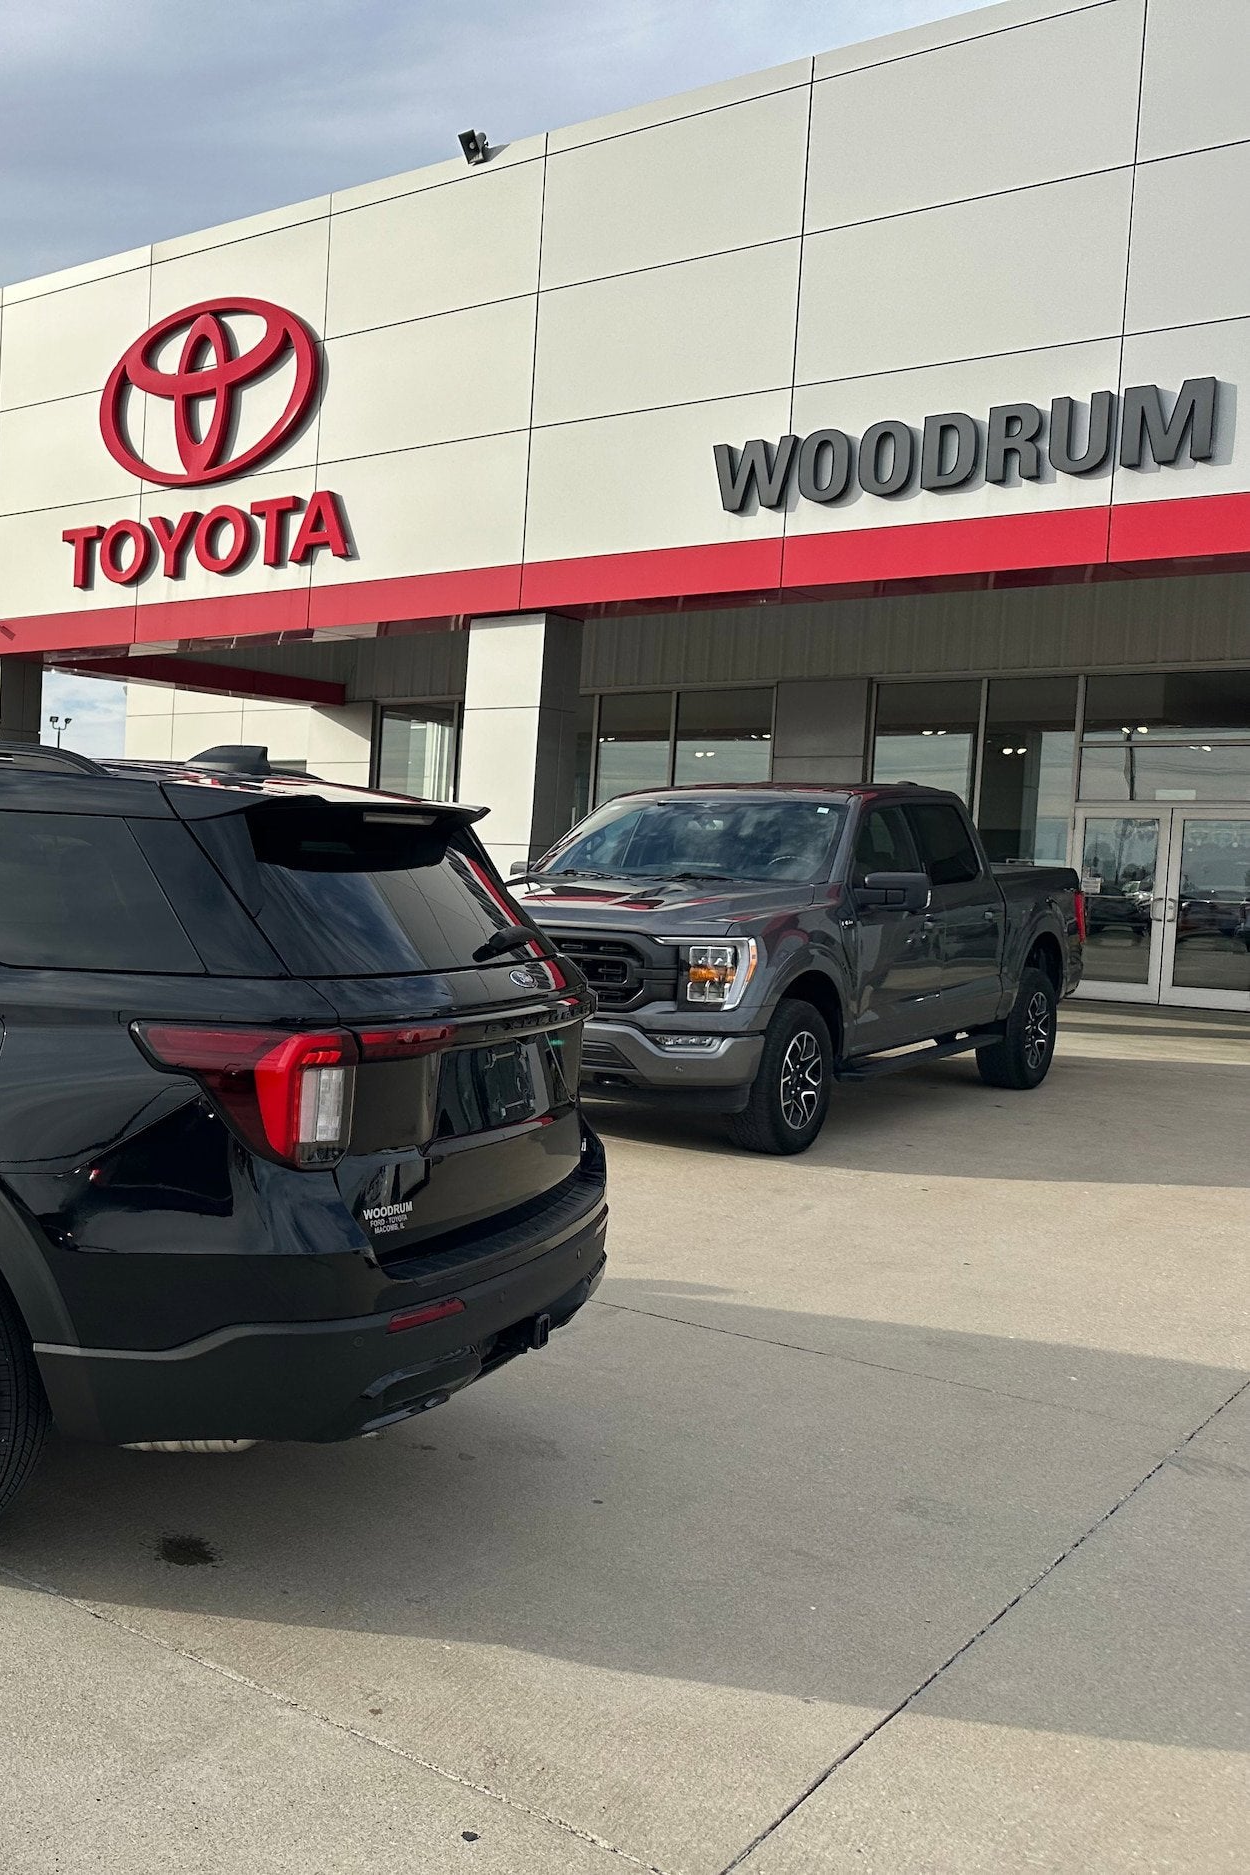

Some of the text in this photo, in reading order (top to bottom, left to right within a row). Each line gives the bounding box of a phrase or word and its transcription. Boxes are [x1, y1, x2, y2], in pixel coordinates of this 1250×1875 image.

[713, 376, 1222, 513] WOODRUM
[62, 491, 351, 588] TOYOTA
[363, 1201, 413, 1220] WOODRUM
[370, 1218, 385, 1227] FORD
[388, 1214, 408, 1223] TOYOTA
